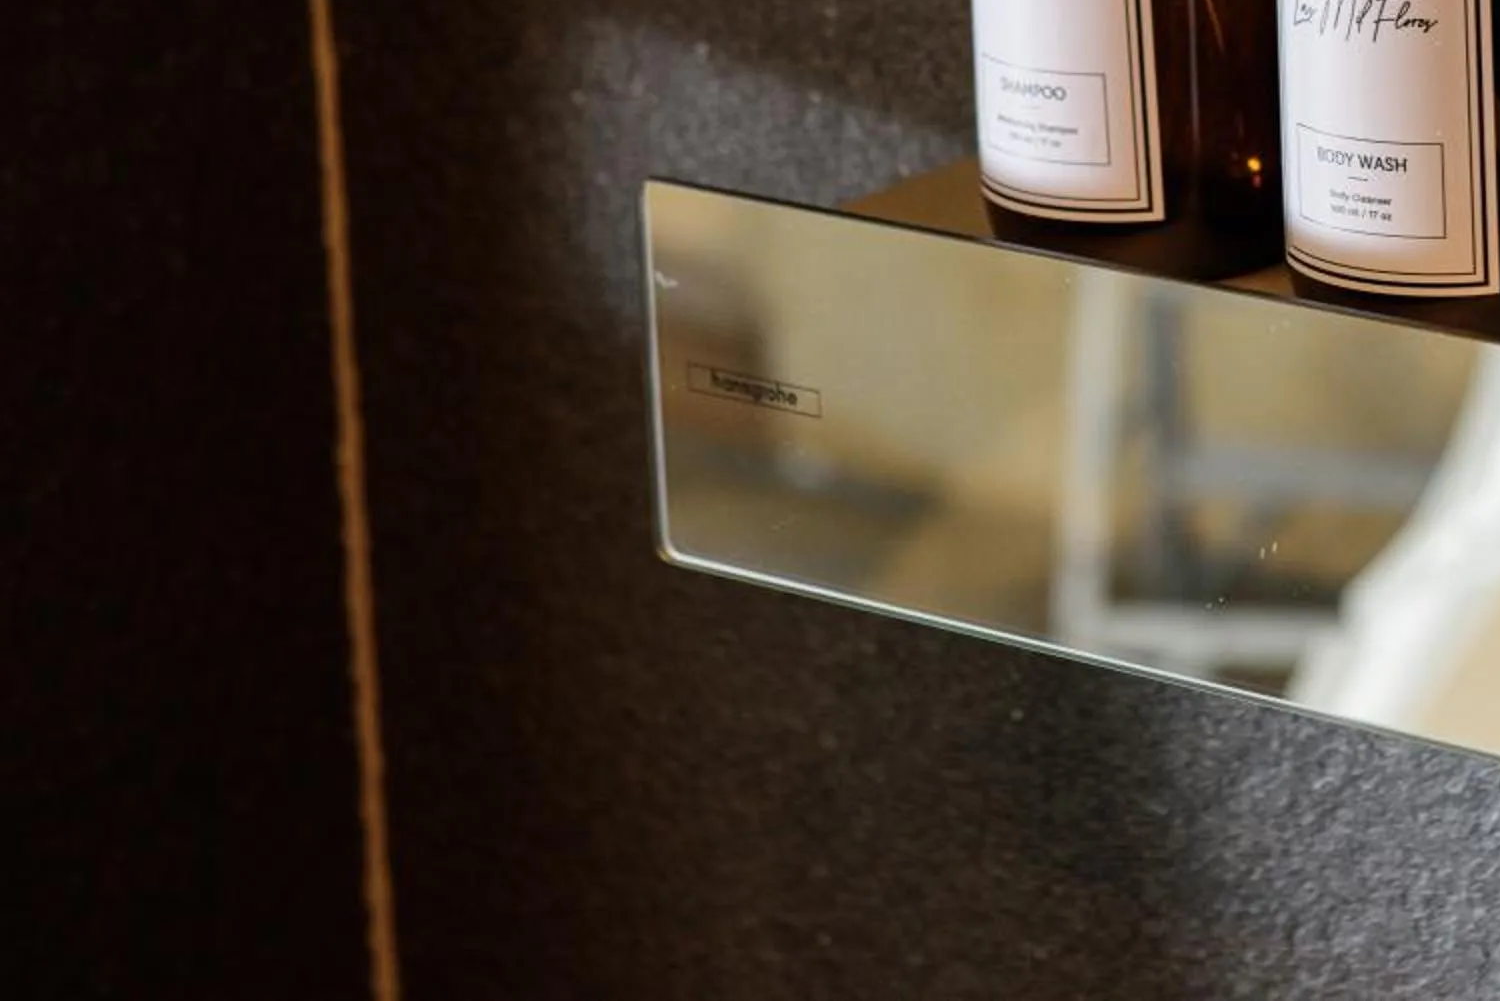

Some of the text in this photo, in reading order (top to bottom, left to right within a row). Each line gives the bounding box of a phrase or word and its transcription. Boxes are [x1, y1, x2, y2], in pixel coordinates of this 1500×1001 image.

[1000, 76, 1069, 102] SHAMPOO
[1317, 145, 1410, 173] BODY WASH
